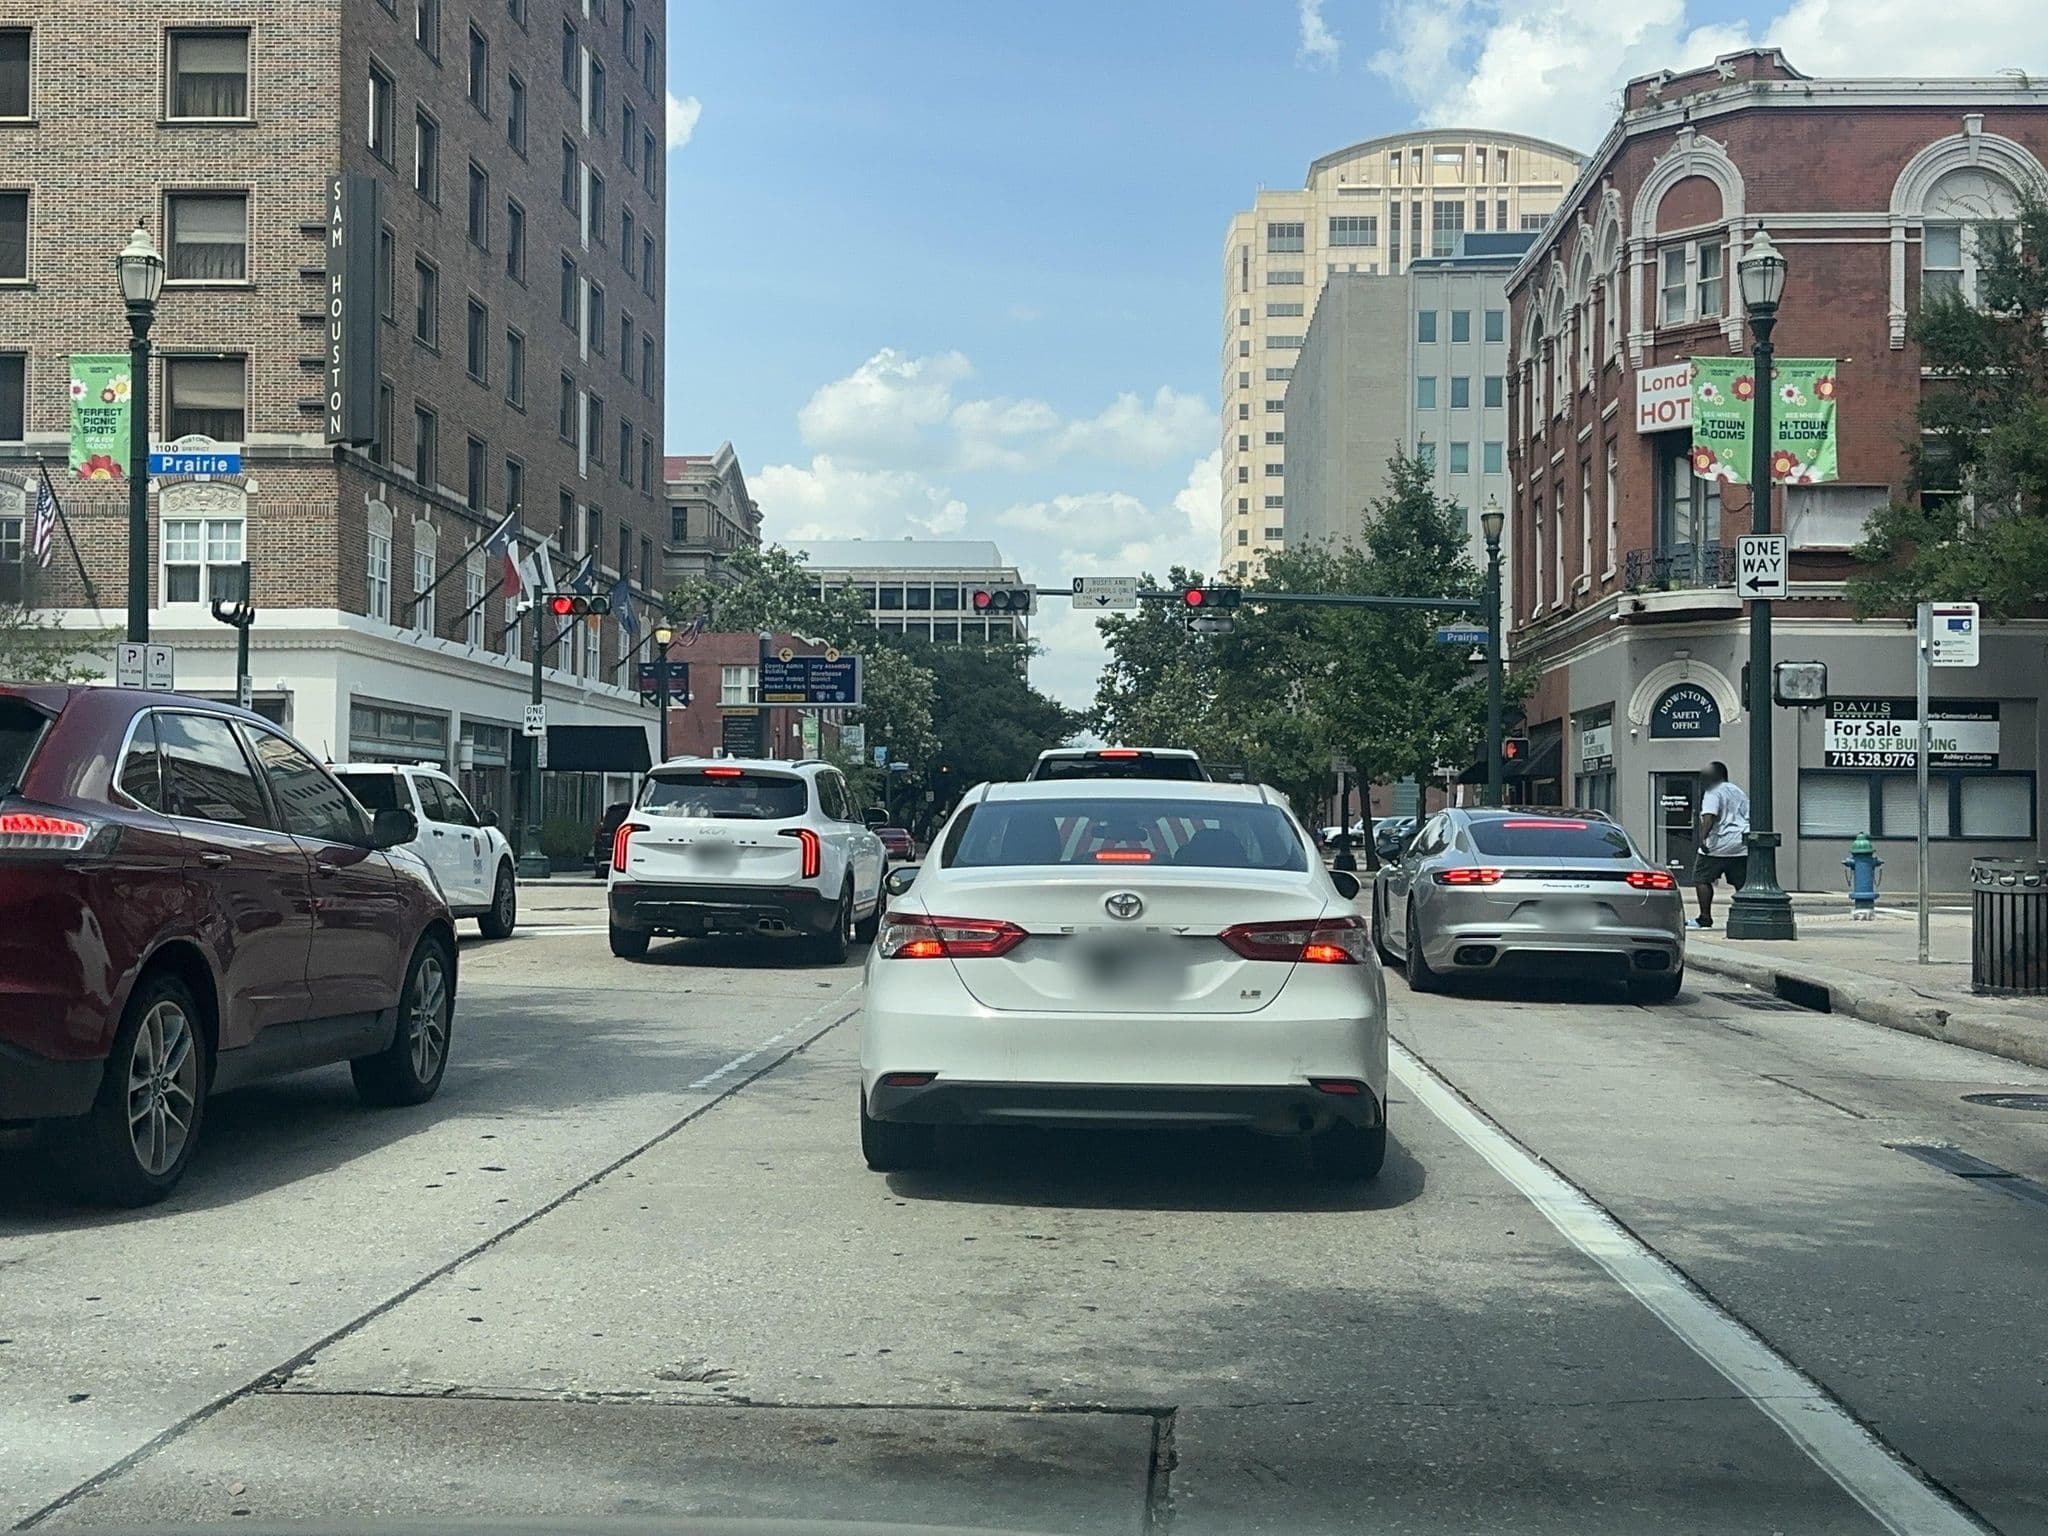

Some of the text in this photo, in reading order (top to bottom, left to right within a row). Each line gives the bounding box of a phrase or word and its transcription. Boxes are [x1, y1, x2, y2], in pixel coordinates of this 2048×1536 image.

[330, 180, 342, 435] SAM HOUSTON
[77, 408, 123, 417] PERFECT
[83, 417, 117, 426] PICNIC
[82, 426, 117, 434] SPOTS
[1779, 431, 1828, 440] BLOOMS
[155, 445, 179, 453] 1100
[162, 456, 228, 473] Prairie
[1743, 541, 1780, 556] ONE
[1742, 558, 1781, 573] WAY
[1660, 690, 1714, 715] DOWNTOWN
[1833, 702, 1891, 712] DAVIS
[526, 706, 544, 715] ONE
[1672, 710, 1701, 720] SAFETY
[525, 715, 544, 723] WAY
[1672, 721, 1701, 730] OFFICE
[1834, 720, 1901, 736] For Sale
[1834, 738, 1875, 751] 13,140
[1878, 738, 1893, 750] SF
[1832, 753, 1915, 767] 713.528.9776
